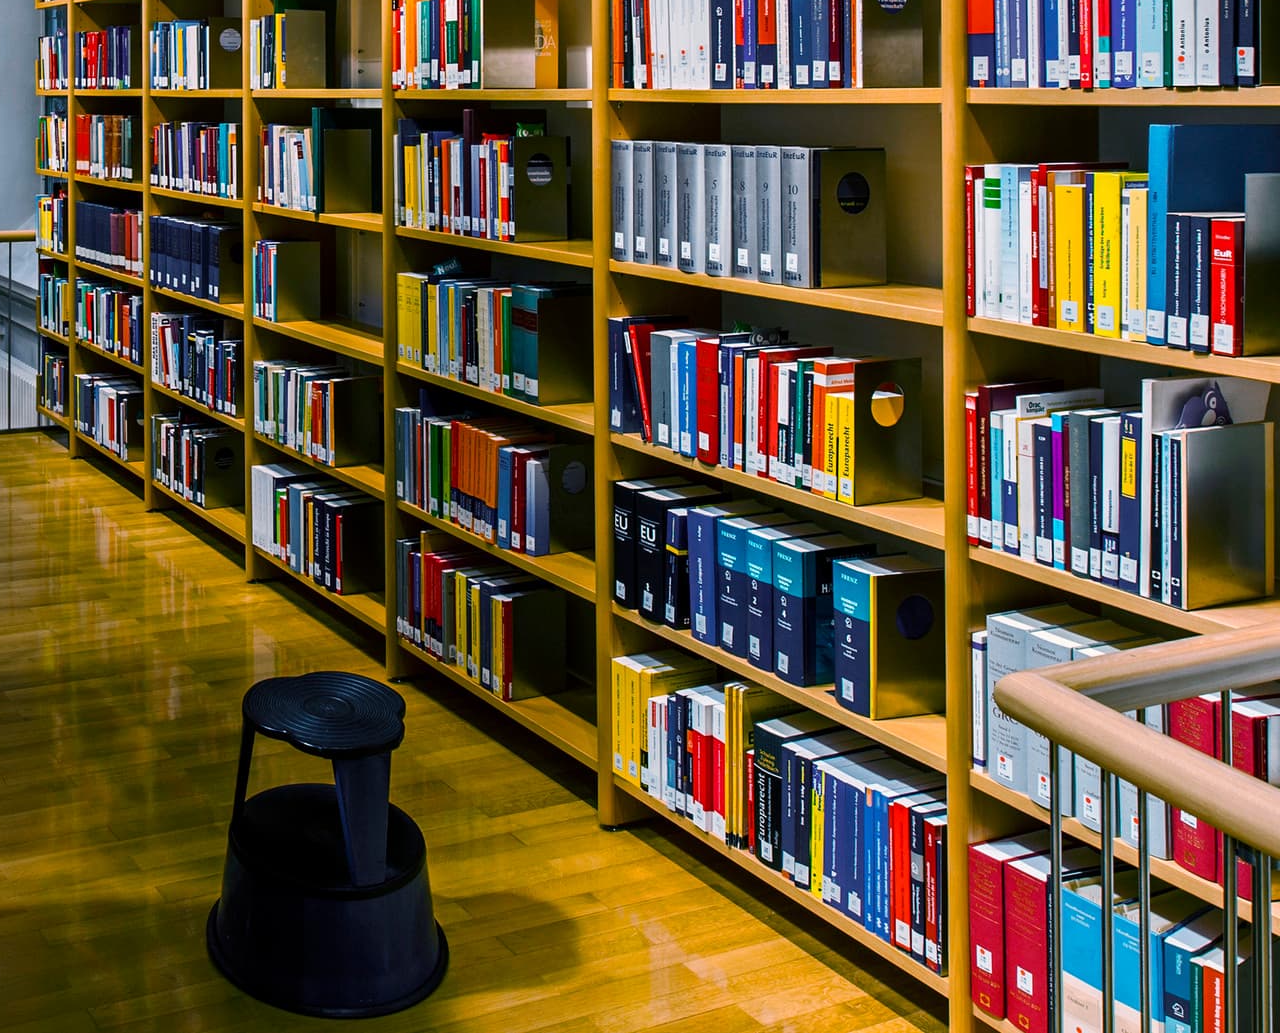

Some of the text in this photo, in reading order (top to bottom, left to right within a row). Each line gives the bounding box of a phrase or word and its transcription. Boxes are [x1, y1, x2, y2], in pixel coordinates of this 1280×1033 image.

[711, 179, 718, 190] 5
[762, 181, 769, 193] 9
[787, 184, 799, 196] 10
[826, 423, 834, 473] Europarecht
[842, 426, 851, 477] Europarecht
[614, 514, 628, 531] EU
[641, 524, 656, 542] EU
[721, 530, 737, 540] FRENZ
[777, 552, 793, 563] FRENZ
[841, 573, 858, 585] FRENZ
[752, 596, 757, 605] 2
[782, 610, 787, 618] 4
[846, 634, 852, 643] 6
[757, 772, 767, 841] Europarecht
